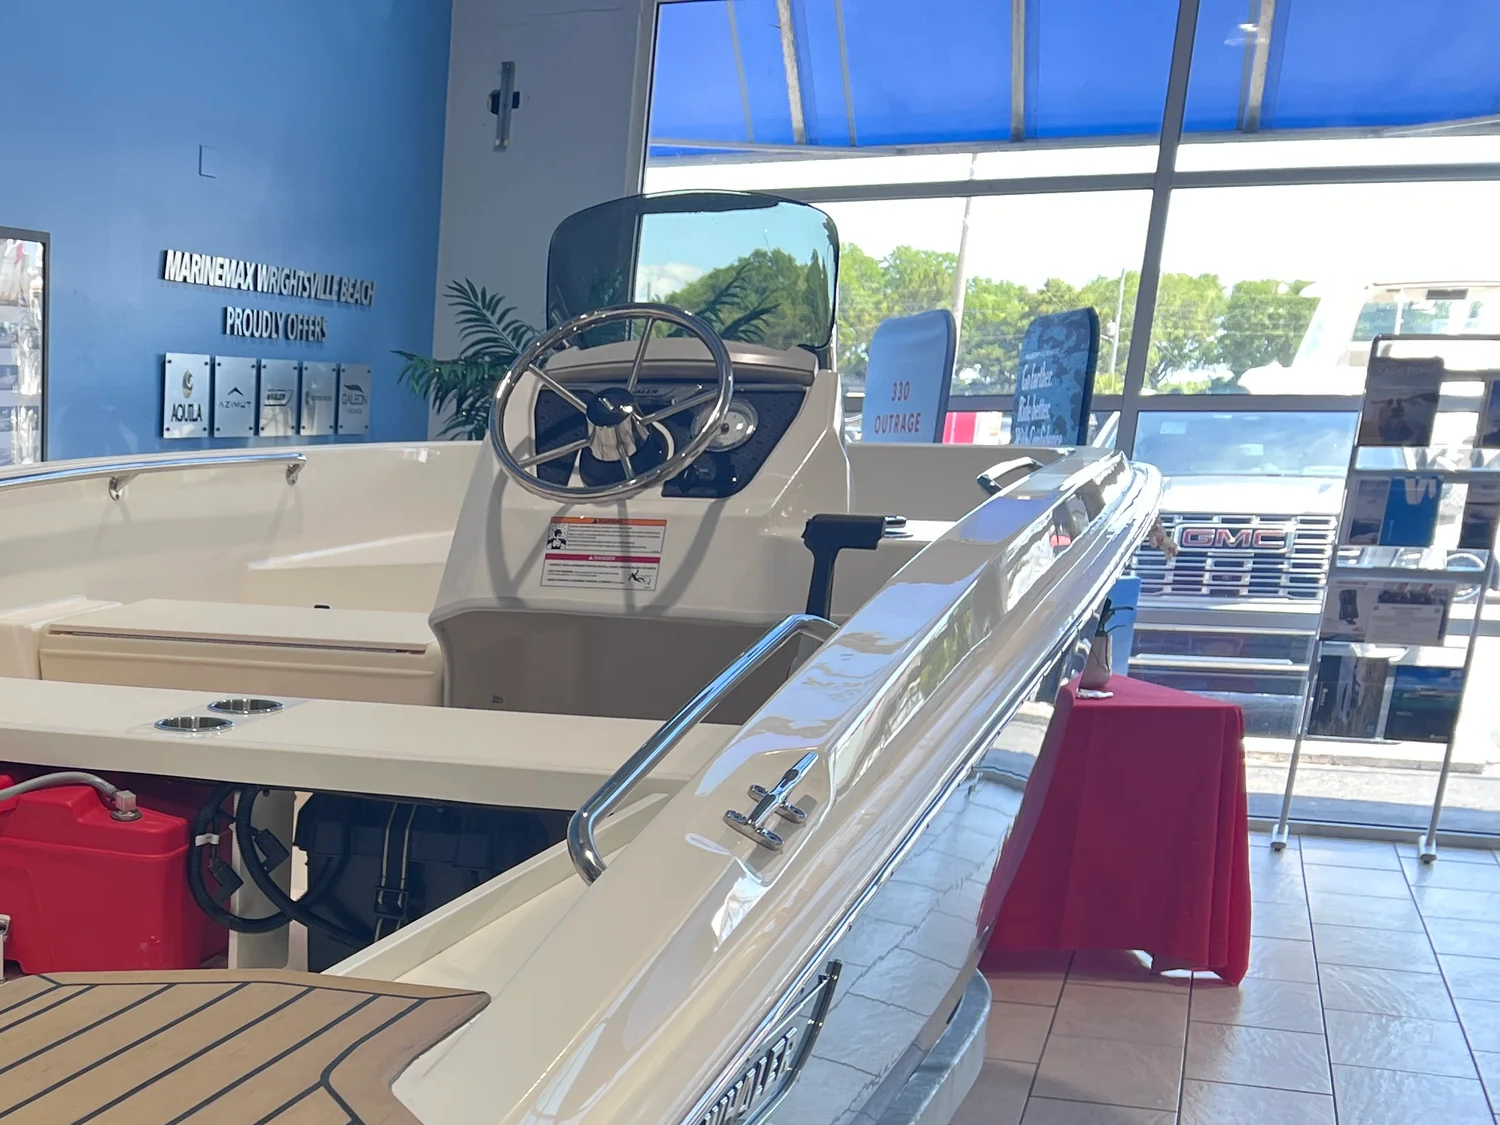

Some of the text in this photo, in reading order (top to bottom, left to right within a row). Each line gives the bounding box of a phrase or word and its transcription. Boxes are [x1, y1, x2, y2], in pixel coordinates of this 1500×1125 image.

[164, 249, 376, 306] MARINEMAX WRIGHTSVILLE BEACH
[225, 306, 327, 342] PROUDLY OFFERS
[891, 380, 910, 402] 330
[171, 403, 203, 422] AQUILA
[1017, 394, 1051, 421] Ride better.
[874, 412, 921, 434] OUTRAGE
[1183, 528, 1287, 548] GMC
